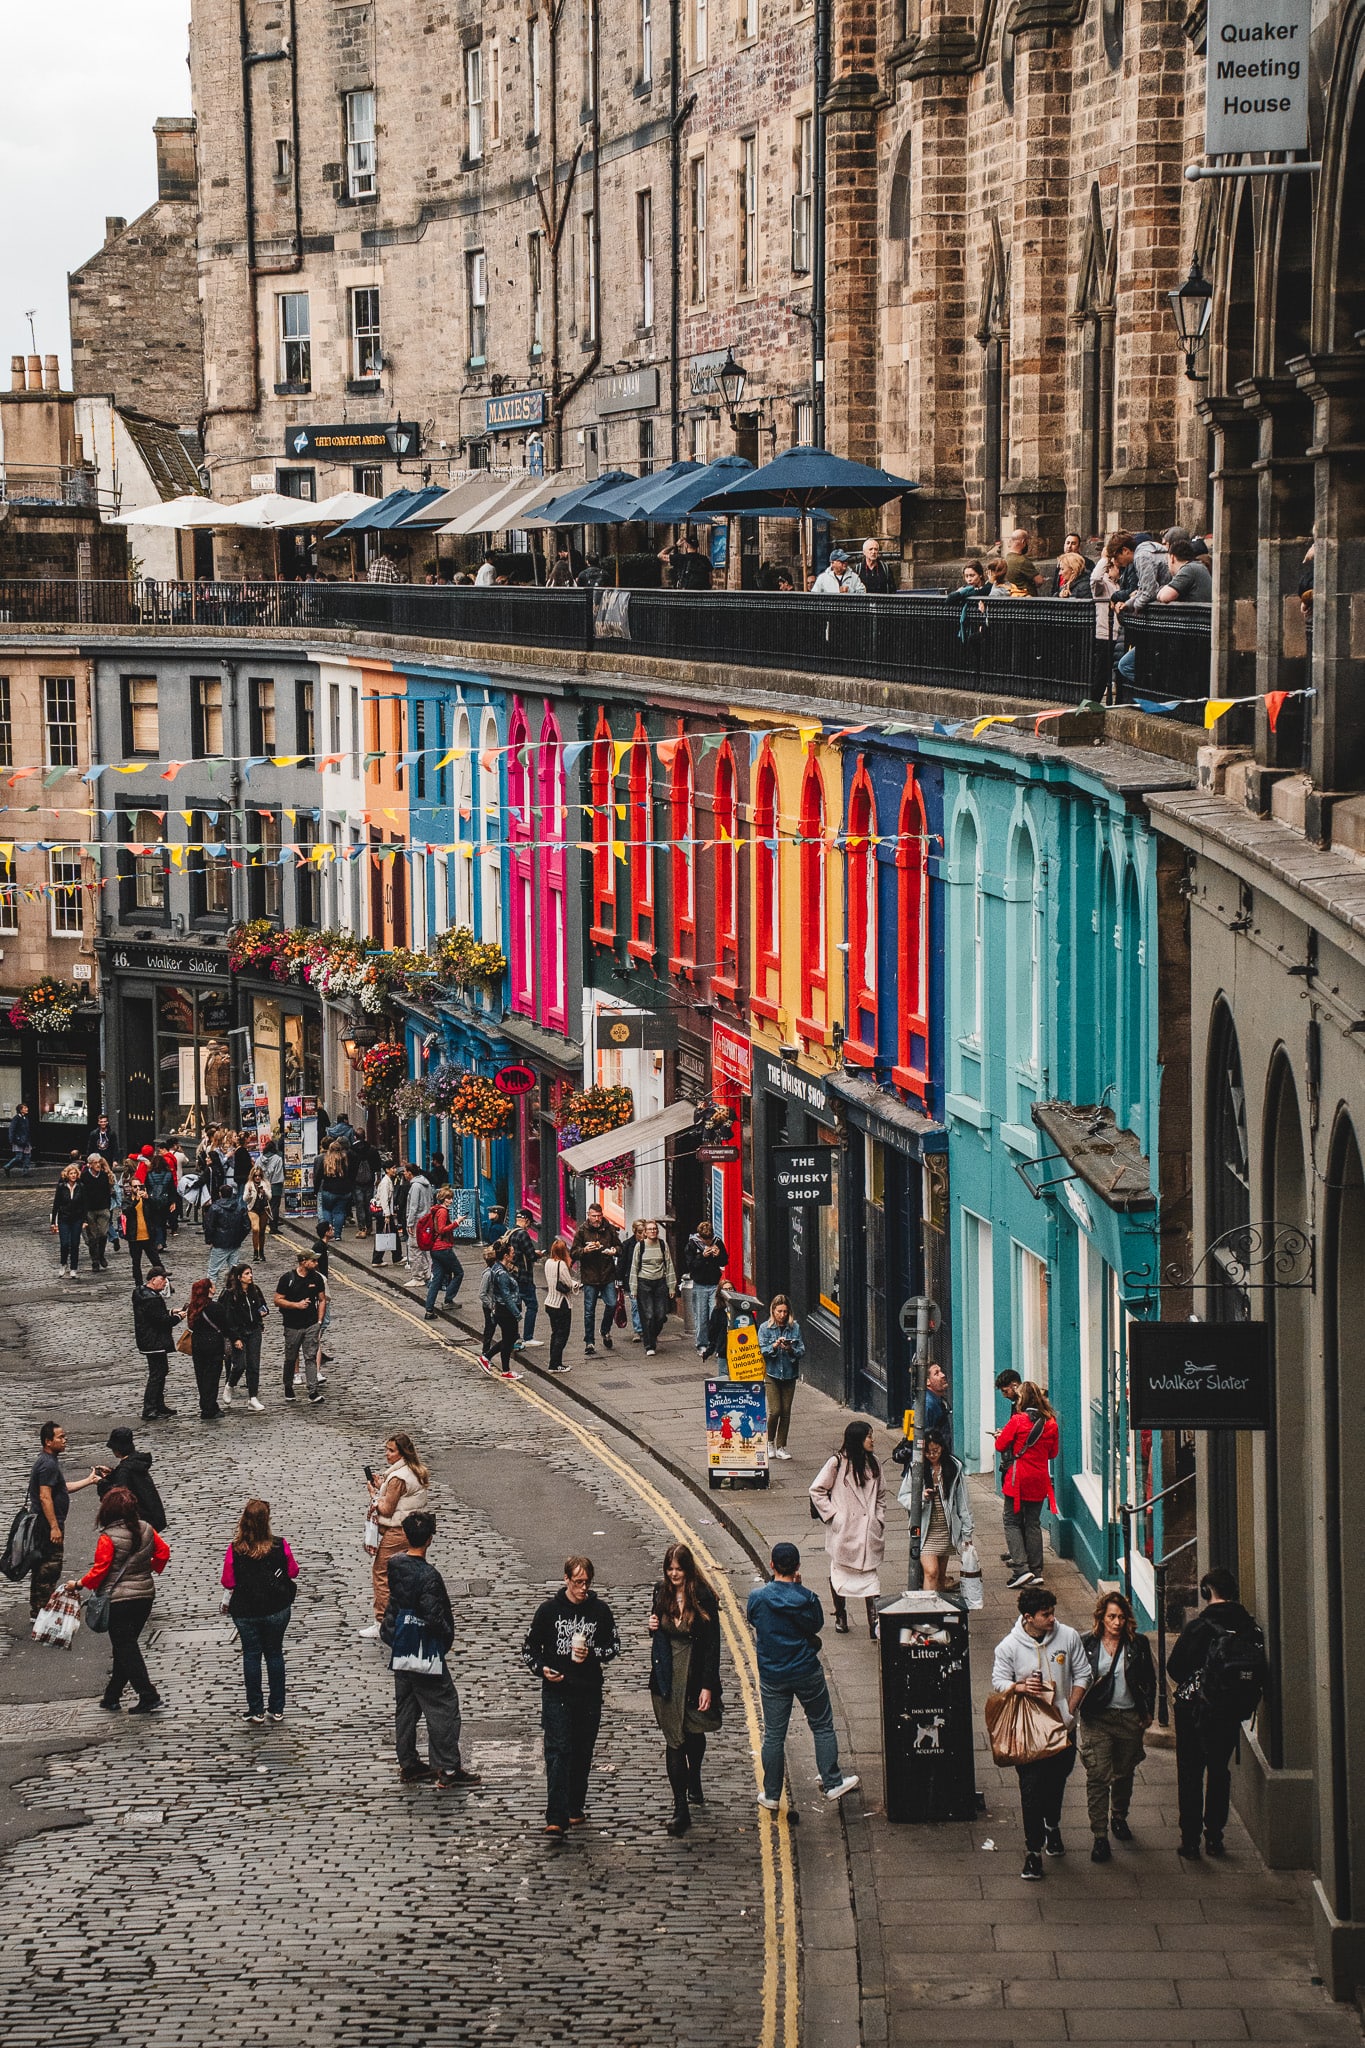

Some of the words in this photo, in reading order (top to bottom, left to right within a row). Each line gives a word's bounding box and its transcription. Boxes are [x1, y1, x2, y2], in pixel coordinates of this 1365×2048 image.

[1221, 22, 1298, 43] Quaker
[1217, 59, 1300, 79] Meeting
[1224, 96, 1291, 114] House
[488, 396, 530, 423] MAXIES
[315, 437, 331, 446] THE
[112, 952, 130, 967] 46.
[148, 955, 182, 970] Walker
[188, 958, 219, 973] Slater
[768, 1064, 780, 1086] THE
[781, 1070, 806, 1100] WHISKY
[808, 1084, 825, 1110] SHOP
[791, 1158, 815, 1166] THE
[778, 1172, 828, 1184] WHISKY
[787, 1190, 820, 1199] SHOP
[739, 1344, 760, 1352] Waitin
[1150, 1374, 1202, 1390] Walker
[1206, 1374, 1249, 1390] Slater
[912, 1650, 940, 1658] Litter
